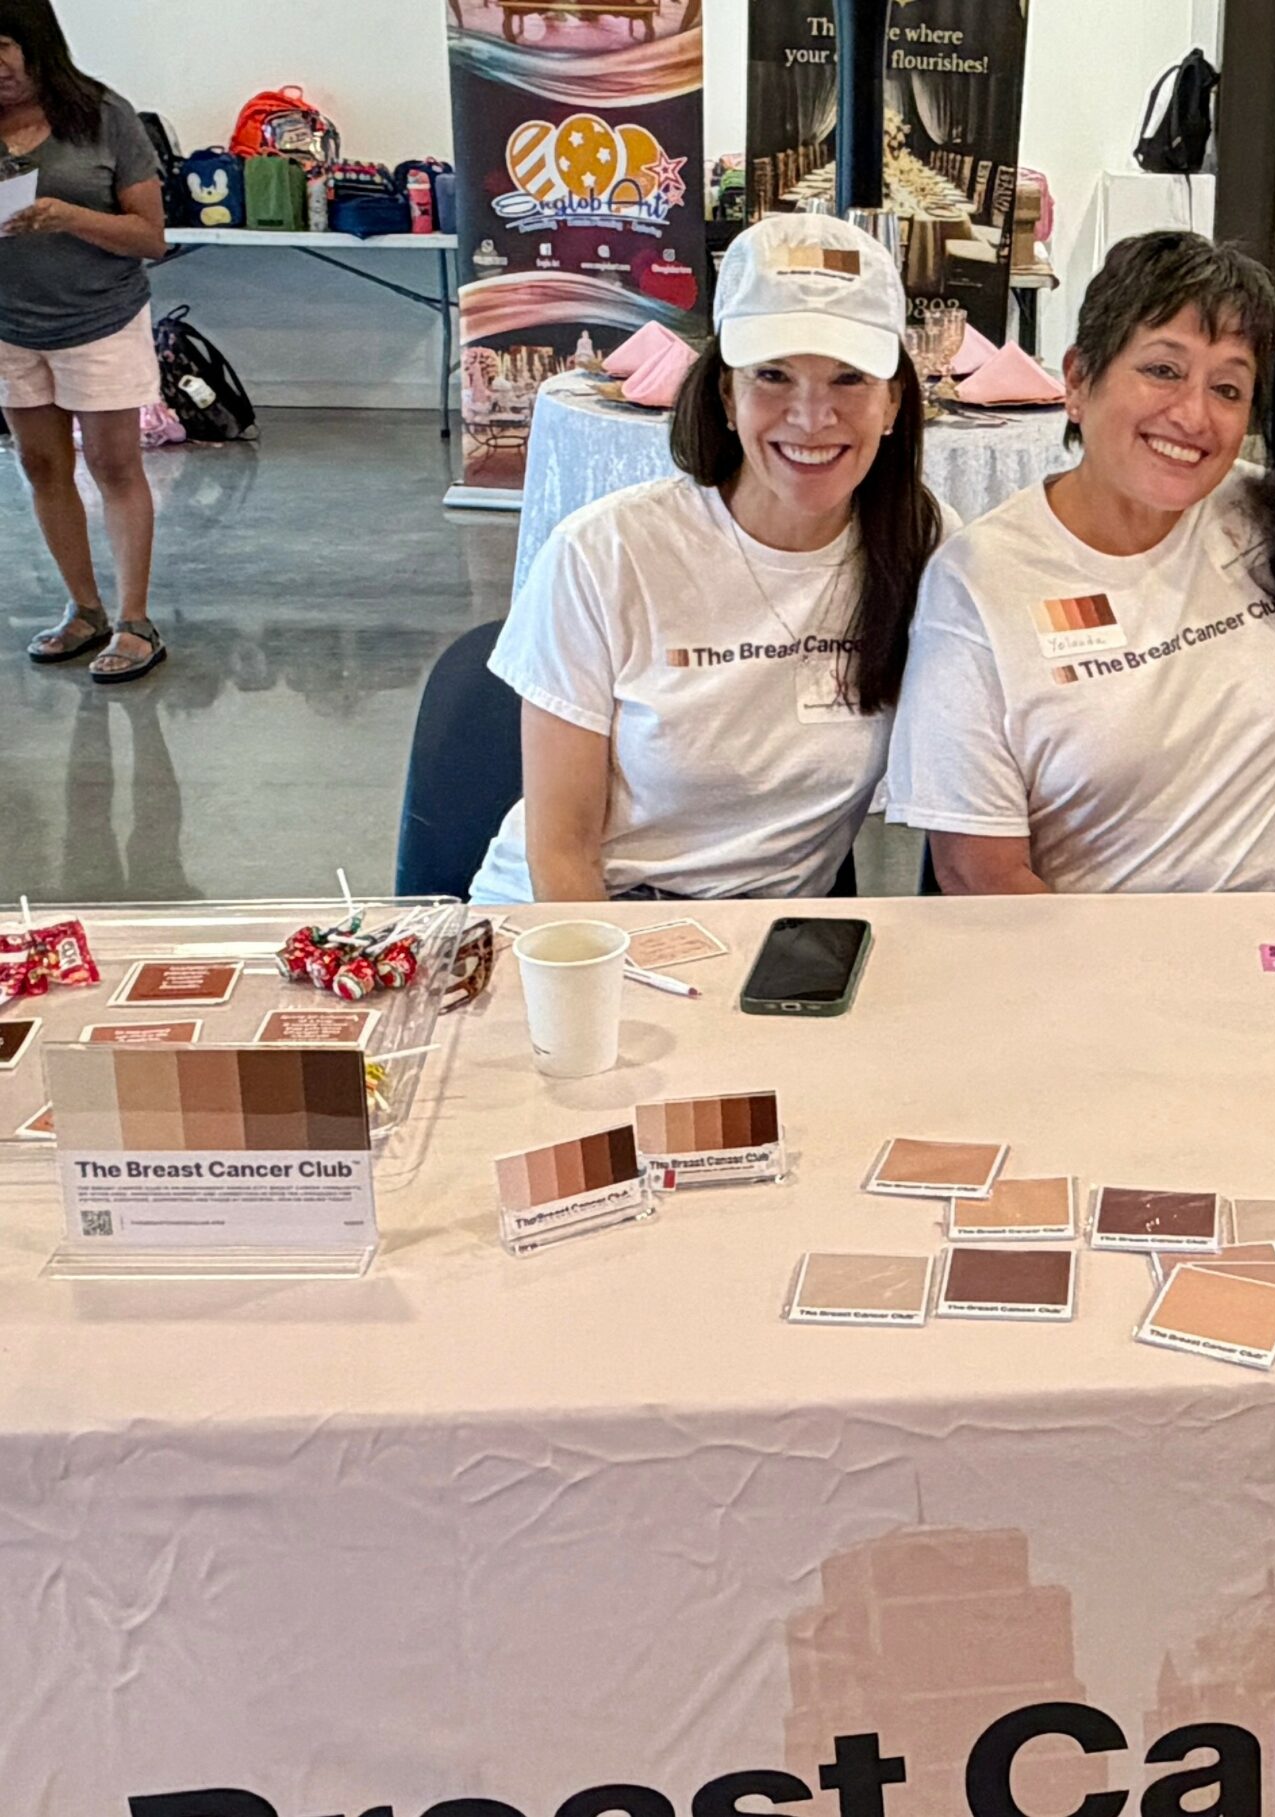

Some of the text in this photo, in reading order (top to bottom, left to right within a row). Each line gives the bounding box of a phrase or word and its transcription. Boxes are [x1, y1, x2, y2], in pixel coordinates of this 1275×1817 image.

[807, 17, 835, 37] Th
[904, 23, 963, 45] where
[784, 47, 989, 74] your flourishes!
[693, 648, 735, 667] The
[739, 638, 801, 660] Breast
[1078, 656, 1124, 679] The
[1123, 636, 1183, 670] Breast
[1182, 612, 1245, 646] Cancer
[74, 1160, 122, 1178] The
[126, 1160, 203, 1178] Breast
[208, 1160, 293, 1178] Cancer
